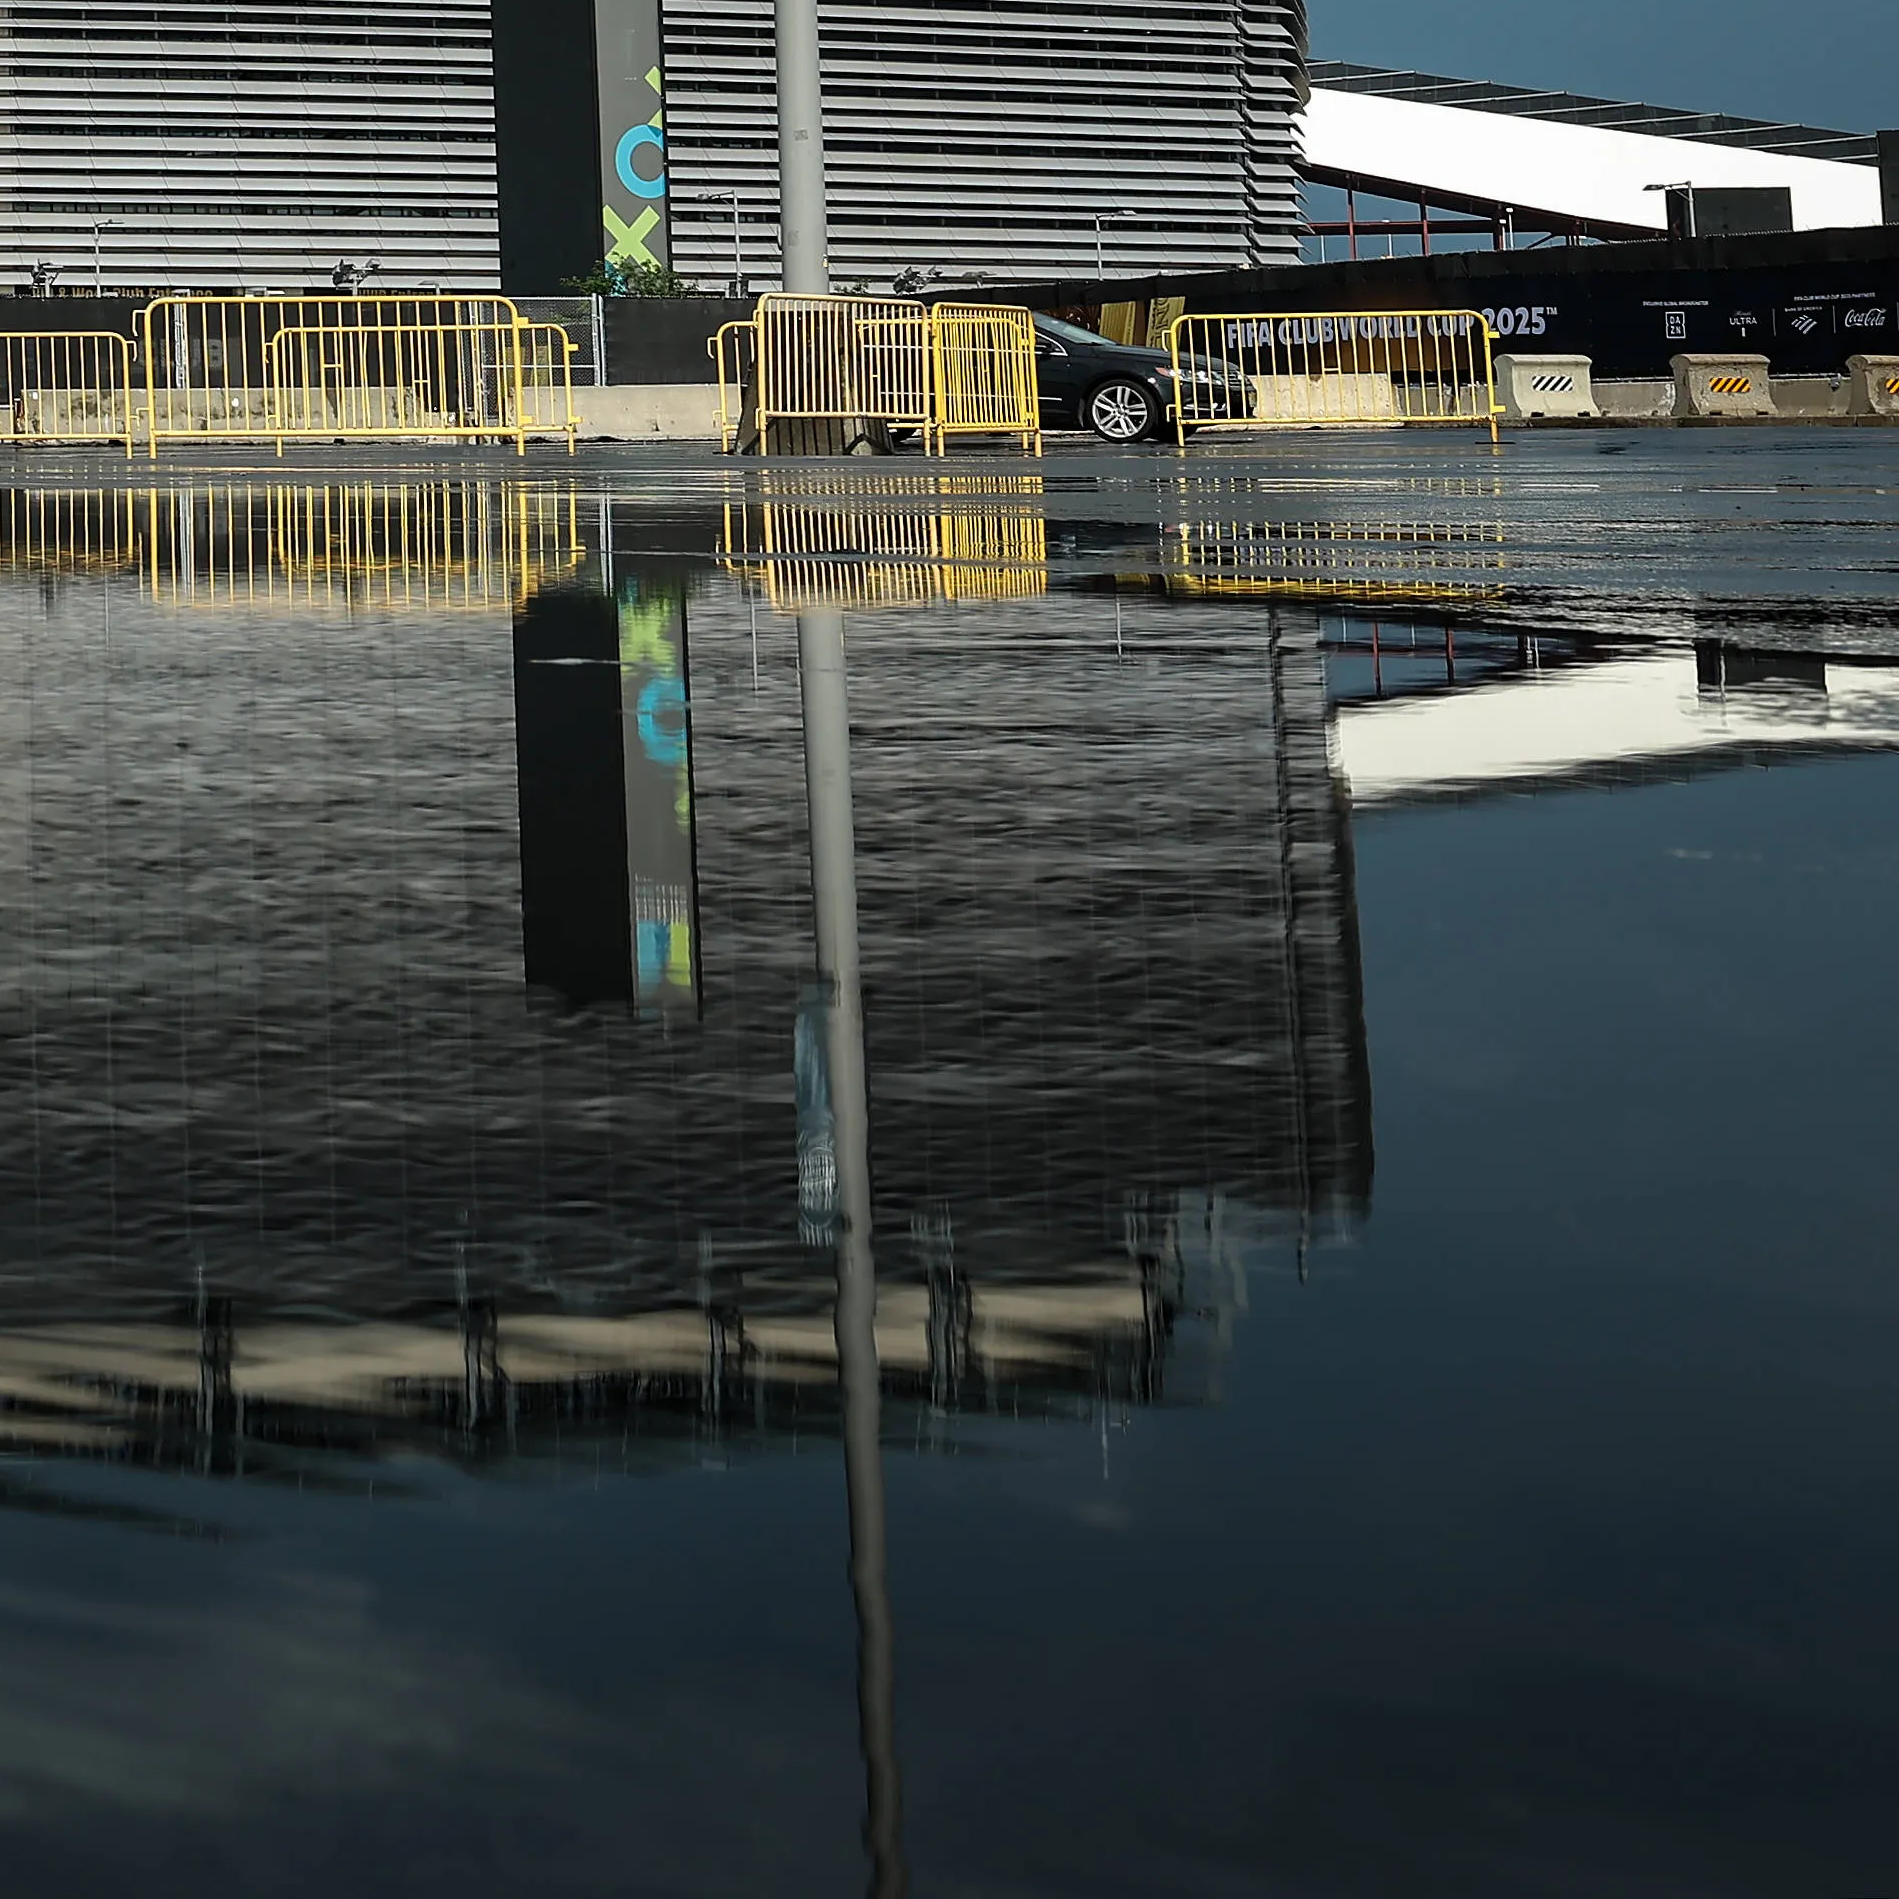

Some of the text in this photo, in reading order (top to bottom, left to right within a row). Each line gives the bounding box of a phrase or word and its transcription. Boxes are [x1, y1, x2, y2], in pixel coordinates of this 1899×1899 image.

[1227, 317, 1271, 349] FIFA
[1278, 317, 1333, 346] CLUB
[1339, 314, 1422, 342] WORLD
[1427, 312, 1475, 338] CUP
[1729, 317, 1757, 325] ULTRA
